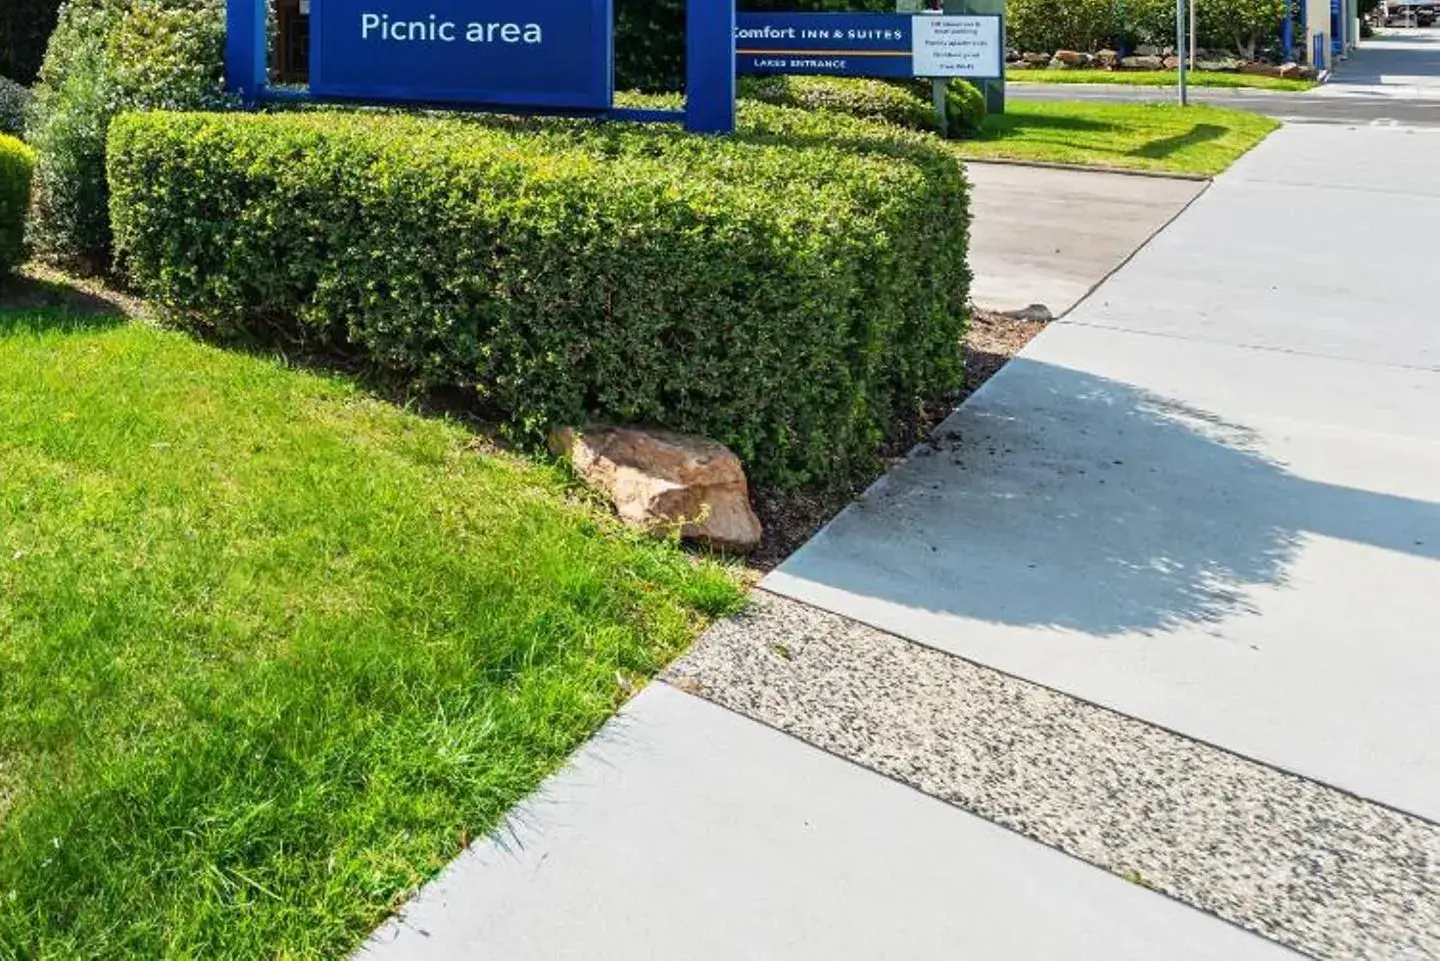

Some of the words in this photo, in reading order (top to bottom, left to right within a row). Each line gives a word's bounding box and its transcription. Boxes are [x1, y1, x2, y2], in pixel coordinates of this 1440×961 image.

[361, 13, 456, 42] Picnic
[466, 18, 542, 44] area
[802, 29, 829, 39] INN
[833, 29, 844, 39] &
[848, 29, 902, 40] SUITES
[754, 59, 786, 68] LAKES
[790, 59, 848, 69] ENTRANCE
